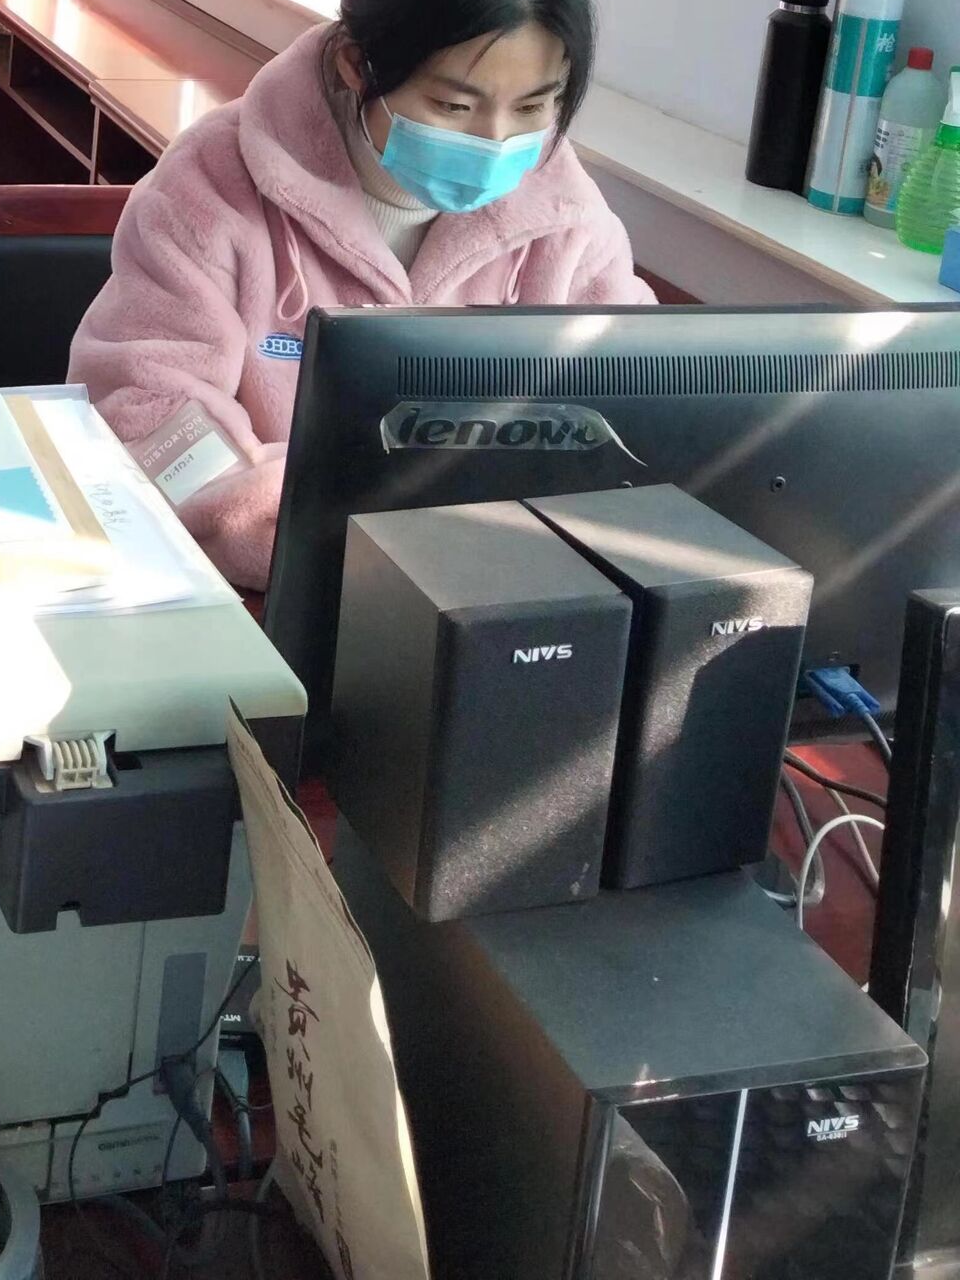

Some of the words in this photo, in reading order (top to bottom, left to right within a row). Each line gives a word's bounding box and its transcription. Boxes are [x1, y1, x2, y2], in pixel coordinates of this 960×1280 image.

[711, 616, 765, 636] NIVS
[513, 644, 573, 664] NIVS
[807, 1115, 860, 1134] NIVS
